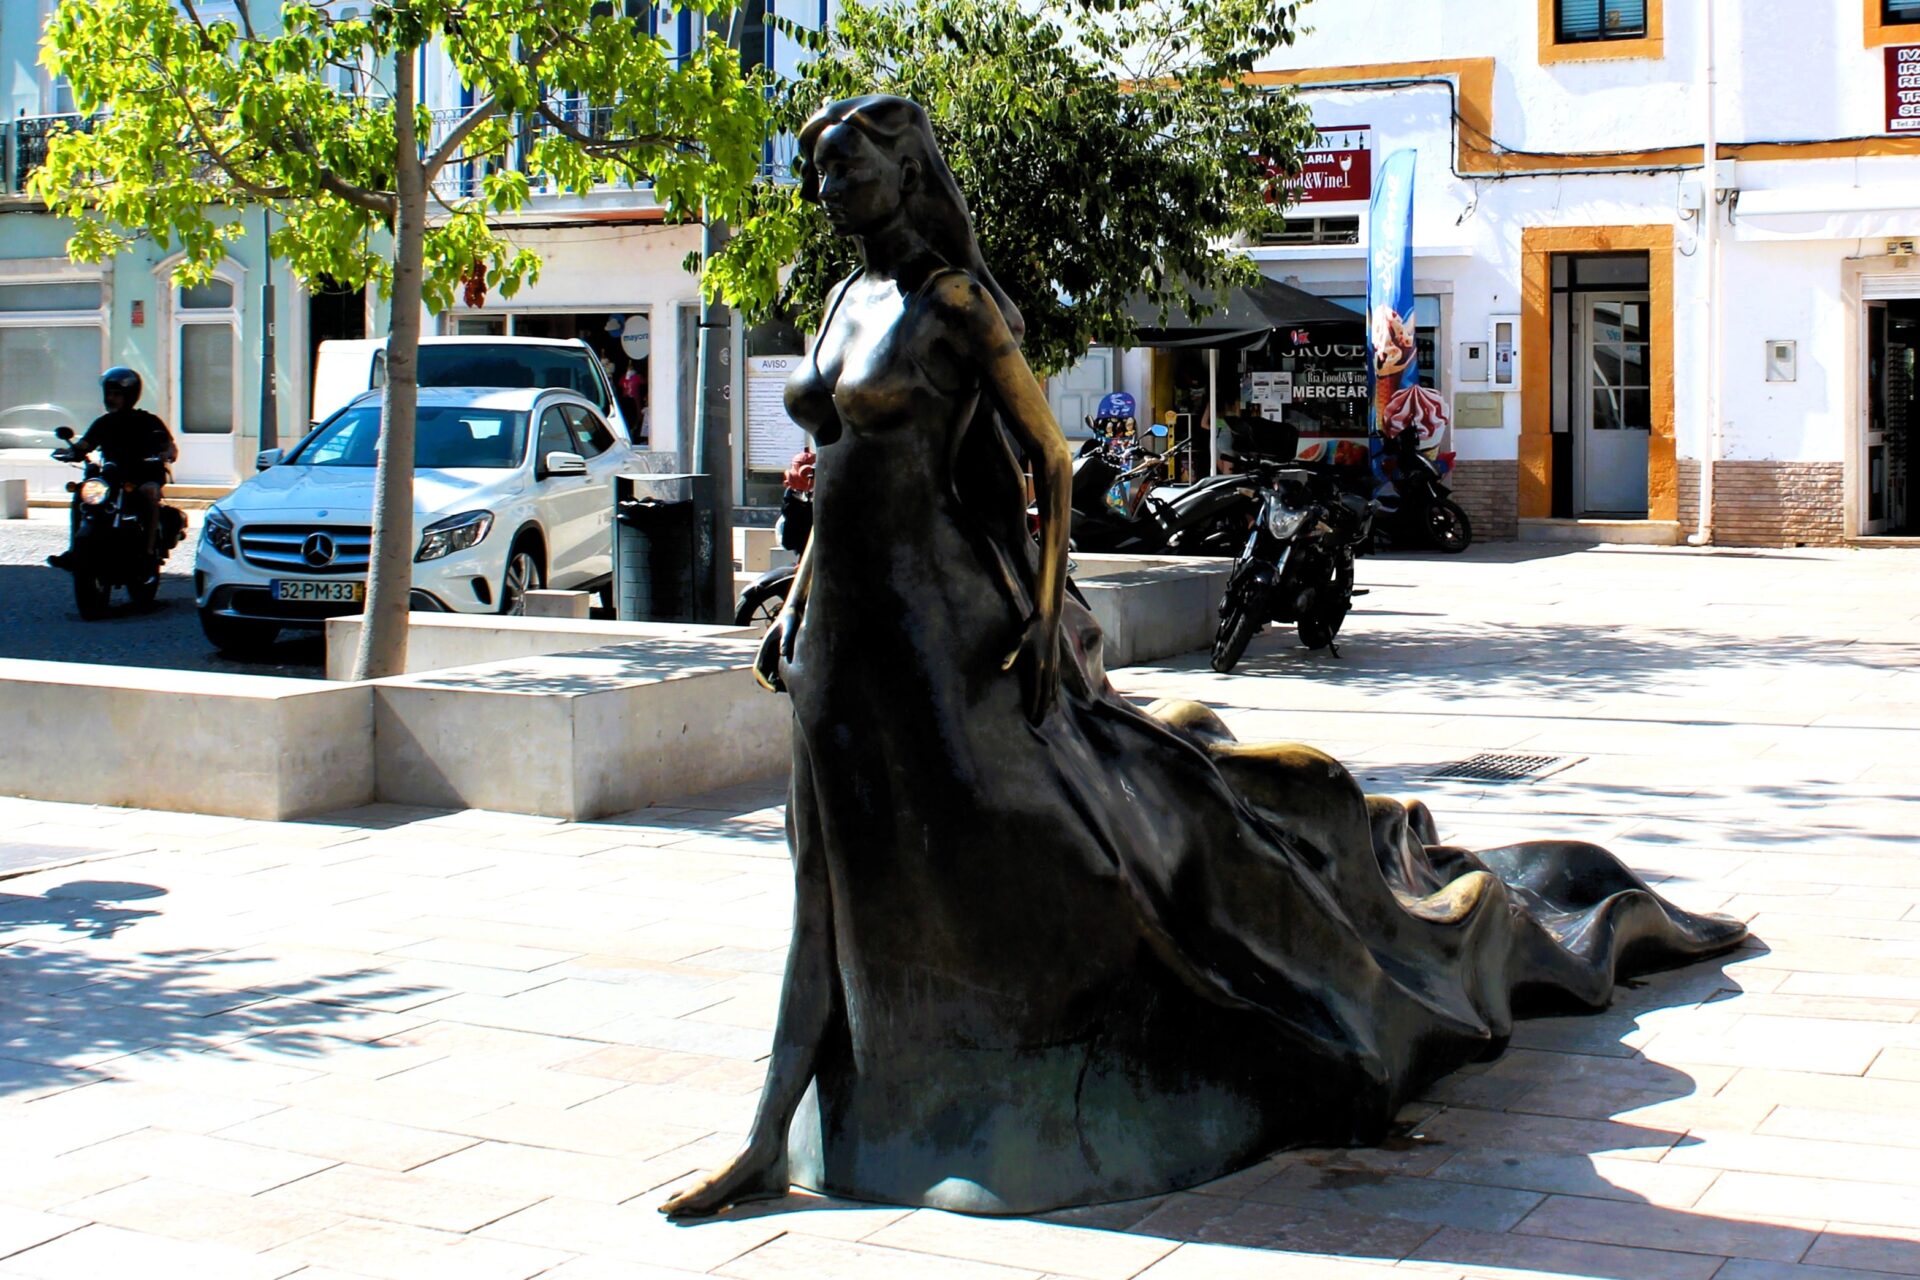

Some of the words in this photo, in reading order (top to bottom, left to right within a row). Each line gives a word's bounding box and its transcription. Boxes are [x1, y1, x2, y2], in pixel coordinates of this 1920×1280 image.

[1898, 49, 1920, 61] IV
[1898, 63, 1920, 75] IR
[762, 359, 787, 369] AVISO
[1292, 385, 1368, 399] MERCEAR
